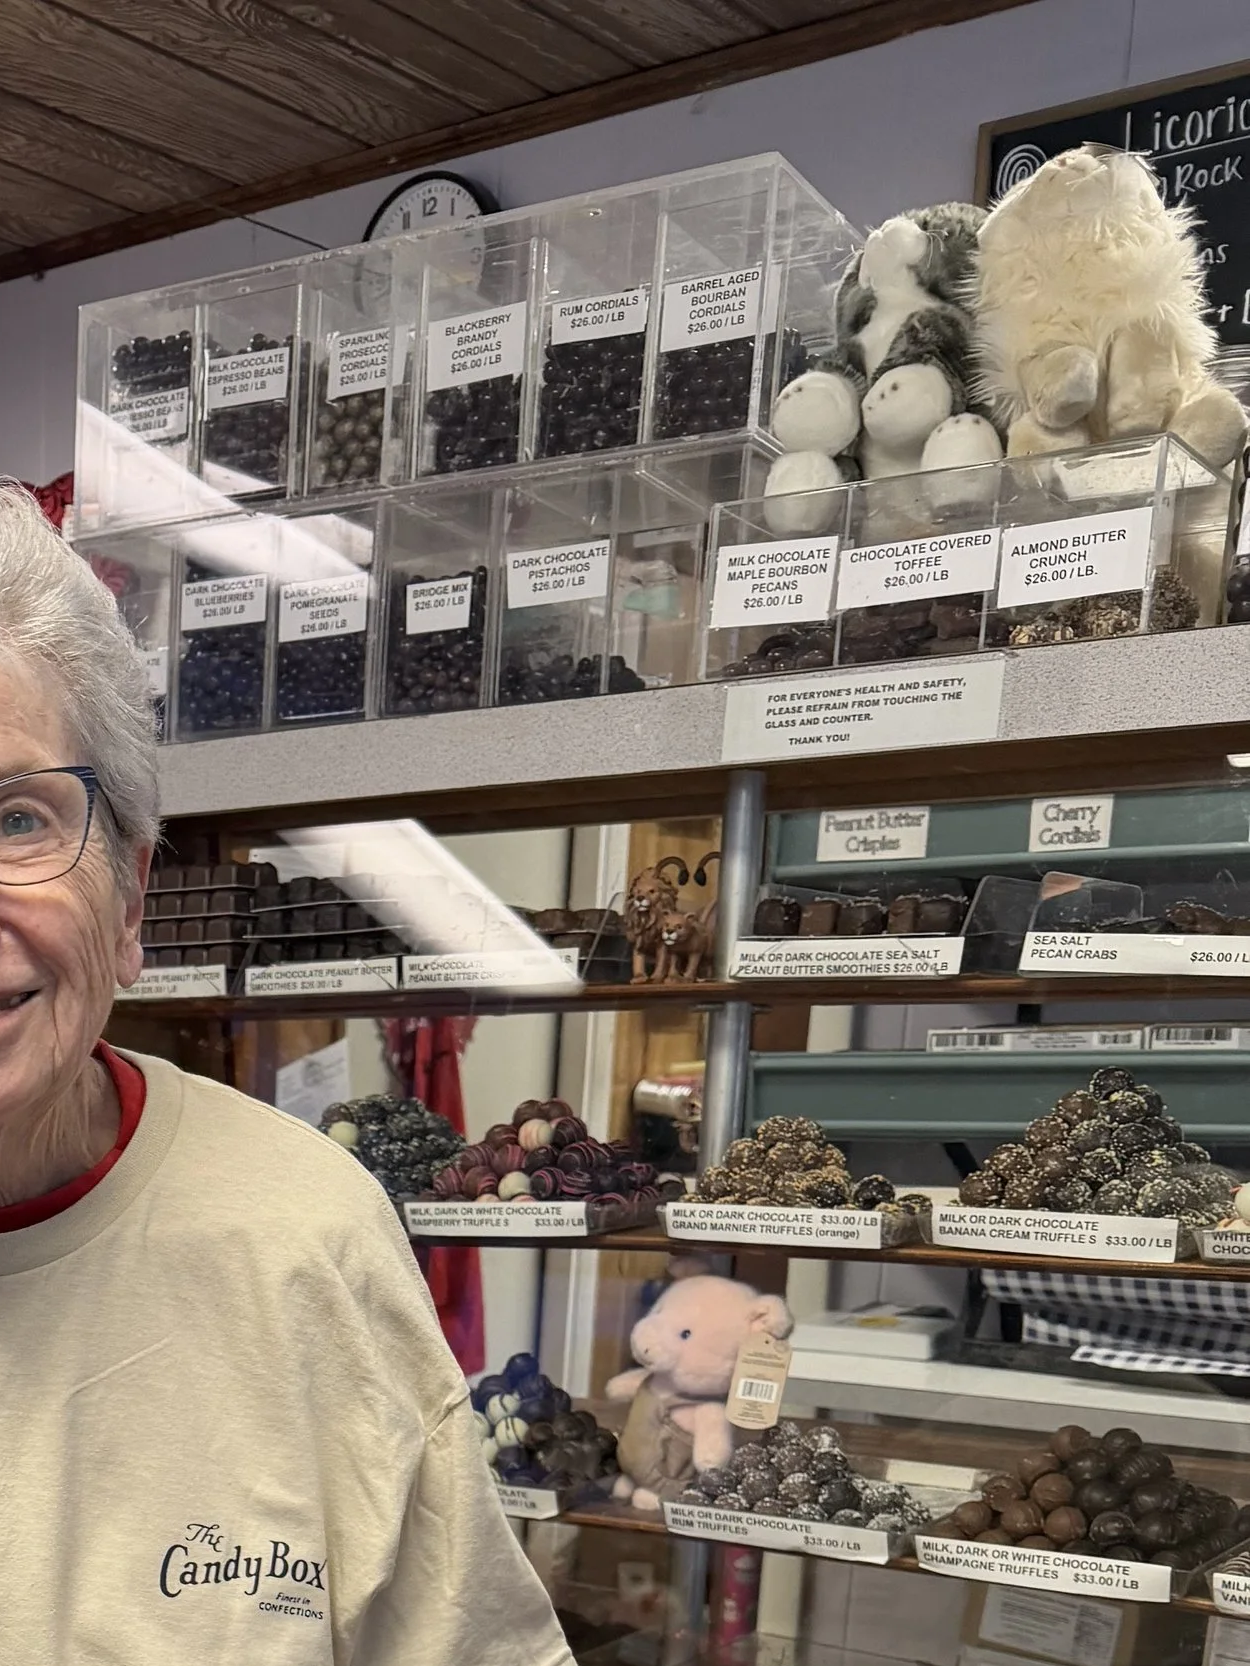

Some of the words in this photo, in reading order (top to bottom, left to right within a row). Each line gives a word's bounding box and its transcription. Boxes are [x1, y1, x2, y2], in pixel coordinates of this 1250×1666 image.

[423, 197, 437, 216] 12
[681, 277, 725, 295] BARREL
[727, 271, 759, 288] AGED
[691, 287, 747, 306] BOURBAN
[559, 303, 580, 318] RUM
[582, 296, 639, 314] CORDIALS
[689, 301, 746, 320] CORDIALS
[445, 313, 512, 337] BLACKBERRY
[457, 328, 497, 347] BRANDY
[451, 341, 502, 360] CORDIALS
[209, 360, 228, 372] MILK
[230, 353, 284, 370] CHOCOLATE
[340, 356, 387, 373] CORDIALS
[208, 370, 252, 386] ESPRESSO
[254, 366, 284, 379] BEANS
[850, 543, 926, 564] CHOCOLATE
[929, 533, 991, 554] COVERED
[1011, 538, 1069, 558] ALMOND
[1072, 529, 1127, 547] BUTTER
[513, 557, 541, 569] DARK
[544, 547, 608, 564] CHOCOLATE
[728, 554, 755, 568] MILK
[758, 548, 830, 565] CHOCOLATE
[894, 555, 942, 572] TOFFEE
[1029, 550, 1087, 570] CRUNCH
[528, 562, 590, 580] PISTACHIOS
[727, 567, 765, 582] MAPLE
[768, 563, 828, 577] BOURBON
[1024, 570, 1067, 587] $26.00
[413, 585, 449, 598] BRIDGE
[452, 583, 468, 593] MIX
[751, 579, 798, 594] PECANS
[768, 693, 787, 703] FOR
[790, 688, 851, 701] EVERYONE'S
[855, 684, 895, 694] HEALTH
[898, 681, 920, 691] AND
[923, 677, 966, 689] SAFETY,
[766, 705, 803, 716] PLEASE
[806, 702, 849, 713] REFRAIN
[851, 698, 880, 709] FROM
[883, 692, 938, 706] TOUCHING
[941, 691, 963, 701] THE
[765, 719, 796, 729] GLASS
[800, 716, 820, 726] AND
[822, 713, 873, 724] COUNTER.
[789, 735, 822, 745] THANK
[826, 733, 850, 743] YOU!
[824, 814, 874, 833] Peanut
[878, 812, 926, 829] Butter
[1043, 803, 1101, 824] Cherry
[1033, 936, 1056, 945] SEA
[1061, 936, 1092, 946] SALT
[740, 952, 766, 962] MILK
[770, 953, 783, 961] OR
[785, 952, 813, 962] DARK
[815, 950, 883, 961] CHOCOLATE
[886, 950, 908, 959] SEA
[911, 949, 940, 959] SALT
[1030, 949, 1072, 959] PECAN
[1075, 950, 1118, 960] CRABS
[738, 965, 782, 975] PEANUT
[783, 964, 824, 974] BUTTER
[825, 963, 890, 974] SMOOTHIES
[672, 1209, 697, 1218] MILK
[698, 1210, 714, 1219] OR
[716, 1210, 745, 1221] DARK
[747, 1212, 813, 1224] CHOCOLATE
[939, 1213, 967, 1224] MILK
[969, 1215, 987, 1225] OR
[989, 1215, 1021, 1226] DARK
[1024, 1217, 1099, 1231] CHOCOLATE
[672, 1221, 708, 1231] GRAND
[709, 1222, 756, 1233] MARNIER
[758, 1224, 813, 1236] TRUFFLES
[815, 1227, 860, 1239] (orange)
[939, 1225, 987, 1238] BANANA
[989, 1228, 1031, 1240] CREAM
[670, 1507, 696, 1518] MILK
[697, 1510, 712, 1520] OR
[714, 1512, 743, 1524] DARK
[746, 1517, 812, 1534] CHOCOLATE
[671, 1518, 694, 1528] RUM
[697, 1521, 748, 1536] TRUFFLES
[185, 1523, 224, 1552] The
[922, 1540, 953, 1555] MILK,
[956, 1544, 989, 1558] DARK
[991, 1549, 1009, 1560] OR
[1012, 1551, 1050, 1566] WHITE
[1052, 1556, 1131, 1576] CHOCOLATE
[160, 1544, 262, 1598] Candy
[265, 1540, 327, 1591] Box
[923, 1552, 995, 1571] CHAMPAGNE
[998, 1562, 1059, 1580] TRUFFLES
[1073, 1572, 1113, 1587] $33.00
[276, 1592, 301, 1605] Finest
[259, 1601, 324, 1620] CONFECTIONS
